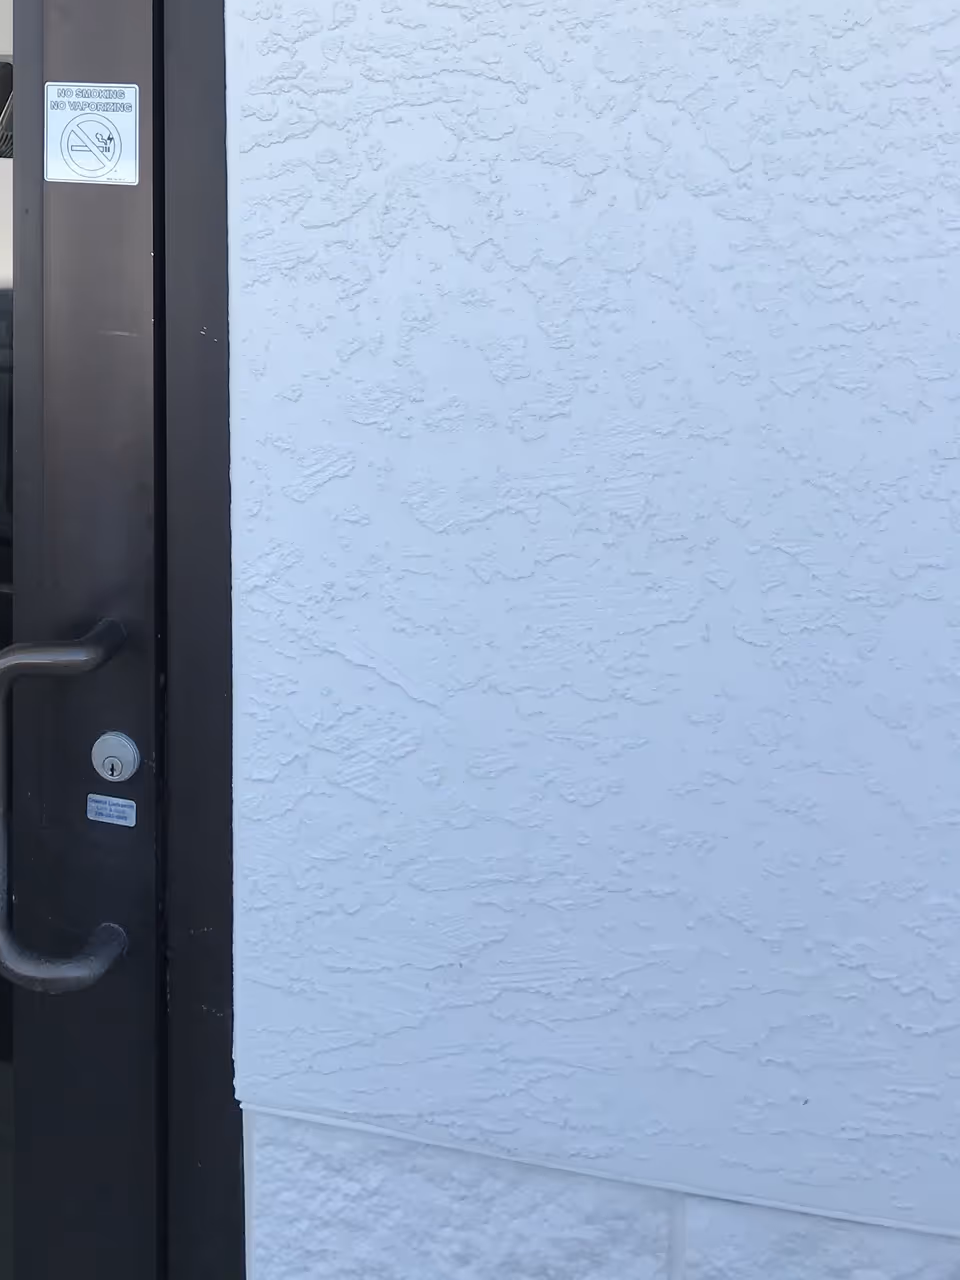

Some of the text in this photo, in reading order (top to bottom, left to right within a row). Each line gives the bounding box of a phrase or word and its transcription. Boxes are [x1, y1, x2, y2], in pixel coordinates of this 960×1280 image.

[56, 87, 125, 100] NO SMOKING
[49, 100, 133, 113] NO VAPORIZING
